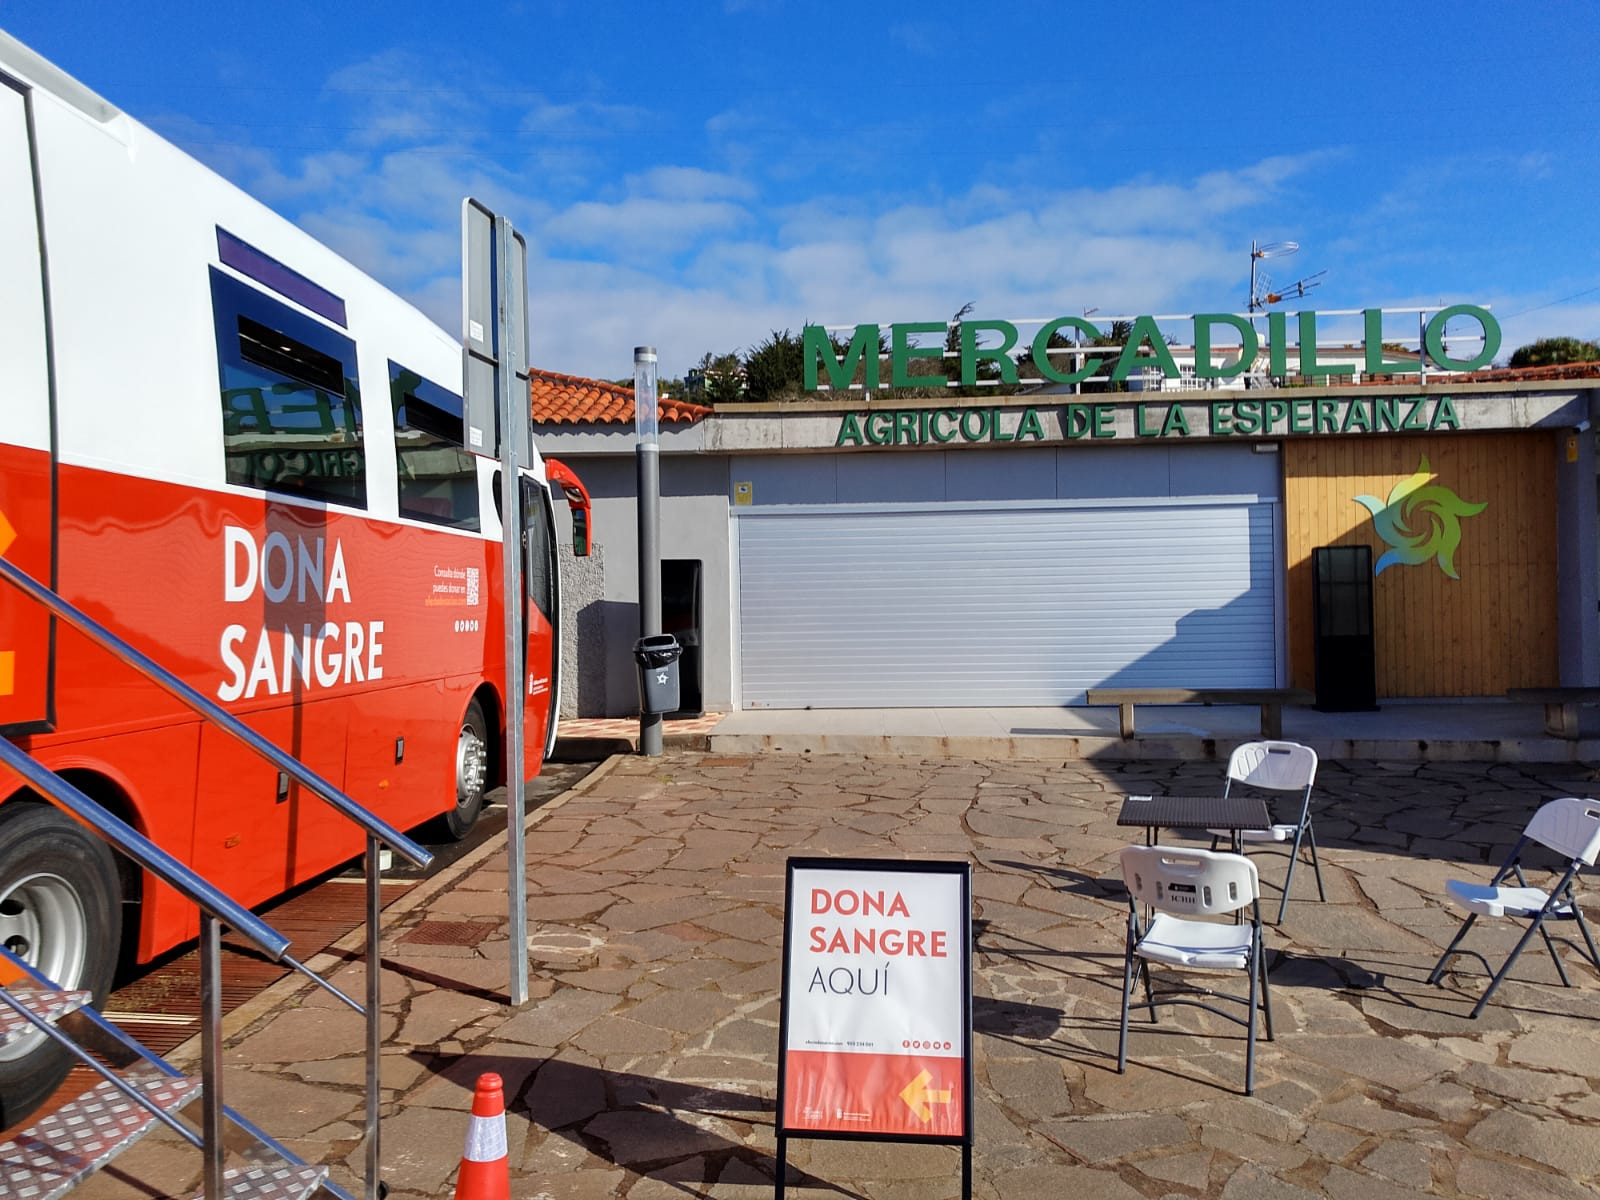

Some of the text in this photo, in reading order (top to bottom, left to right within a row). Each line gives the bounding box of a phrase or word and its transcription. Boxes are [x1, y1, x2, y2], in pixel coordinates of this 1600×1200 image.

[803, 304, 1502, 391] MERCADILLO
[836, 396, 1461, 446] AGRICOLA DE LA ESPERANZA
[224, 525, 352, 604] DONA
[217, 621, 384, 702] SANGRE
[811, 888, 910, 918] DONA
[809, 926, 947, 958] SANGRE
[808, 961, 890, 996] AQUÍ
